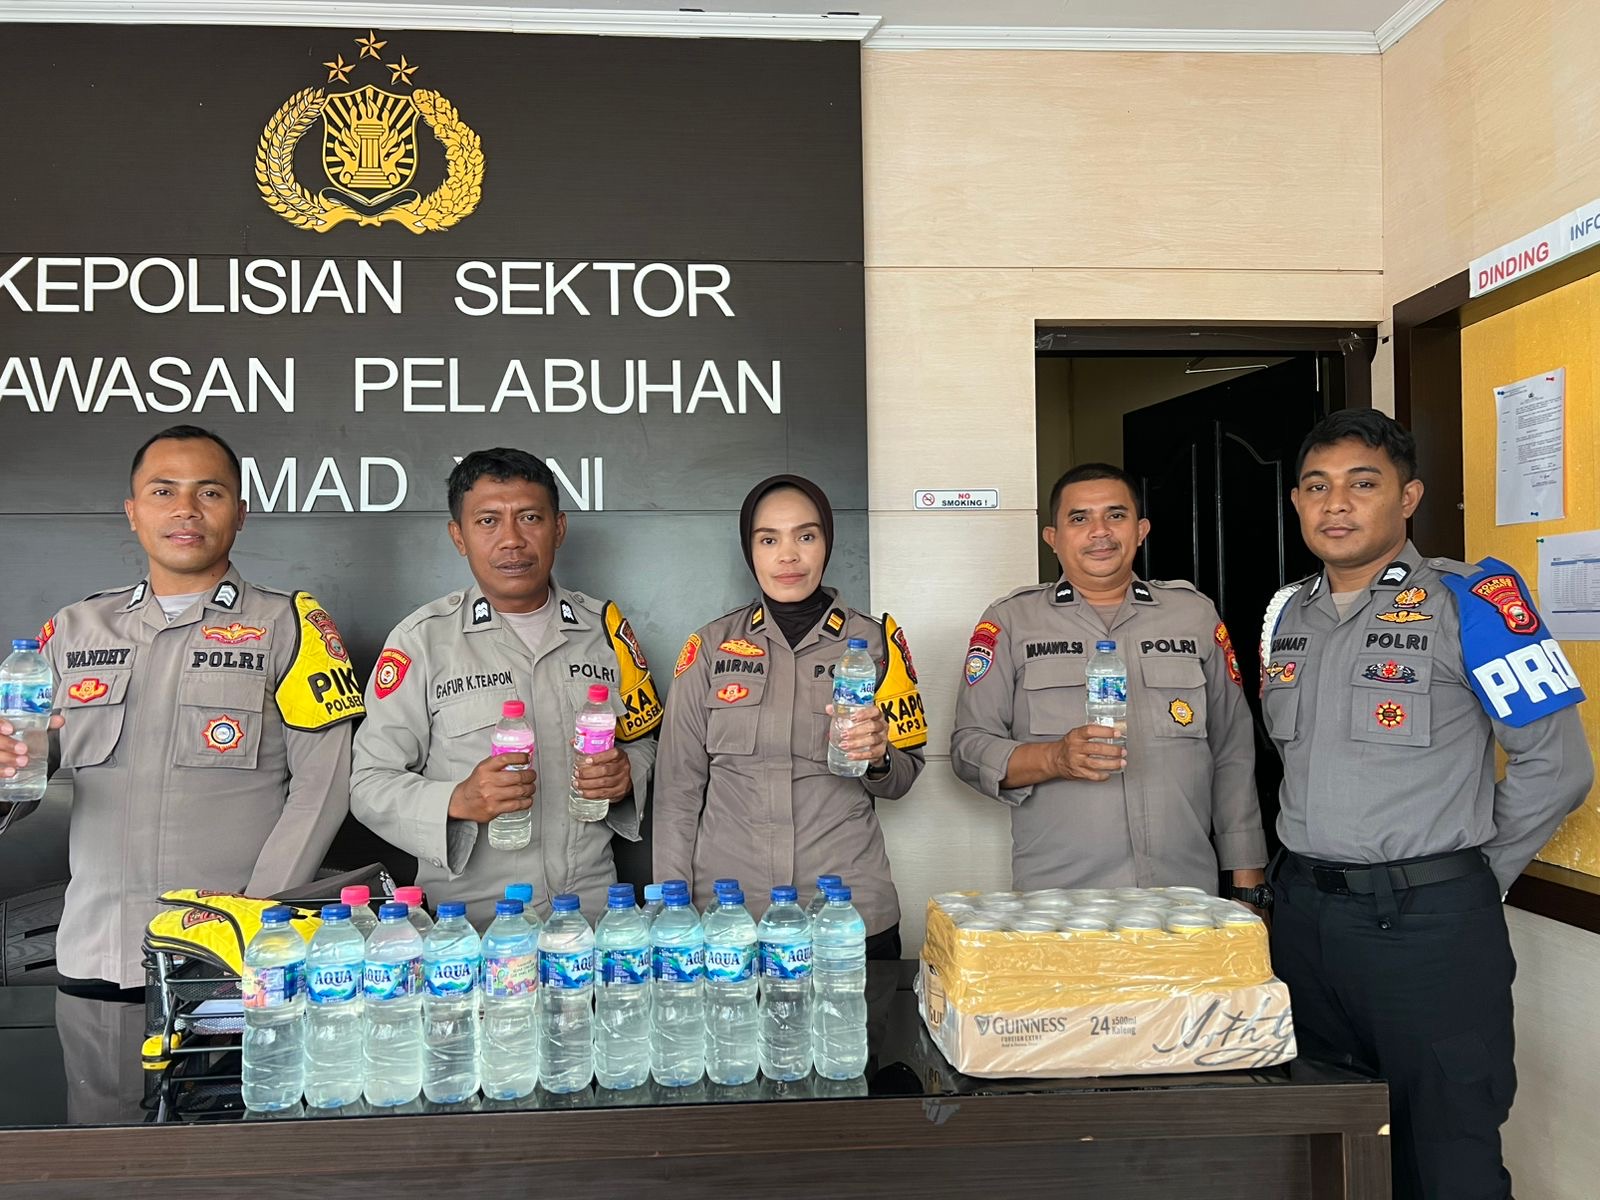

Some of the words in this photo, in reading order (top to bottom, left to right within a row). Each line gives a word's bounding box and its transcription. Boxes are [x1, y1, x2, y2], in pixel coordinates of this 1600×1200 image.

[1478, 241, 1549, 290] DINDING
[0, 256, 402, 315] KEPOLISIAN
[454, 261, 735, 318] SEKTOR
[0, 356, 294, 413] AWASAN
[355, 357, 781, 414] PELABUHAN
[241, 456, 408, 513] MAD
[941, 499, 982, 507] SMOKING
[1140, 639, 1197, 655] POLRI
[1366, 633, 1428, 651] POLRI
[66, 648, 131, 669] WANDHY
[191, 651, 265, 671] POLRI
[714, 659, 764, 675] MIRNA
[569, 663, 615, 682] POLRI
[436, 677, 464, 699] GAFUR
[465, 670, 513, 691] K.TEAPON
[626, 704, 660, 732] POLSEK
[897, 718, 921, 735] KP3
[708, 951, 740, 968] AQUA
[788, 946, 812, 963] AQU
[314, 969, 353, 986] AQUA
[434, 963, 472, 981] AQUA
[992, 1016, 1066, 1036] GUINNESS
[1090, 1015, 1110, 1036] 24
